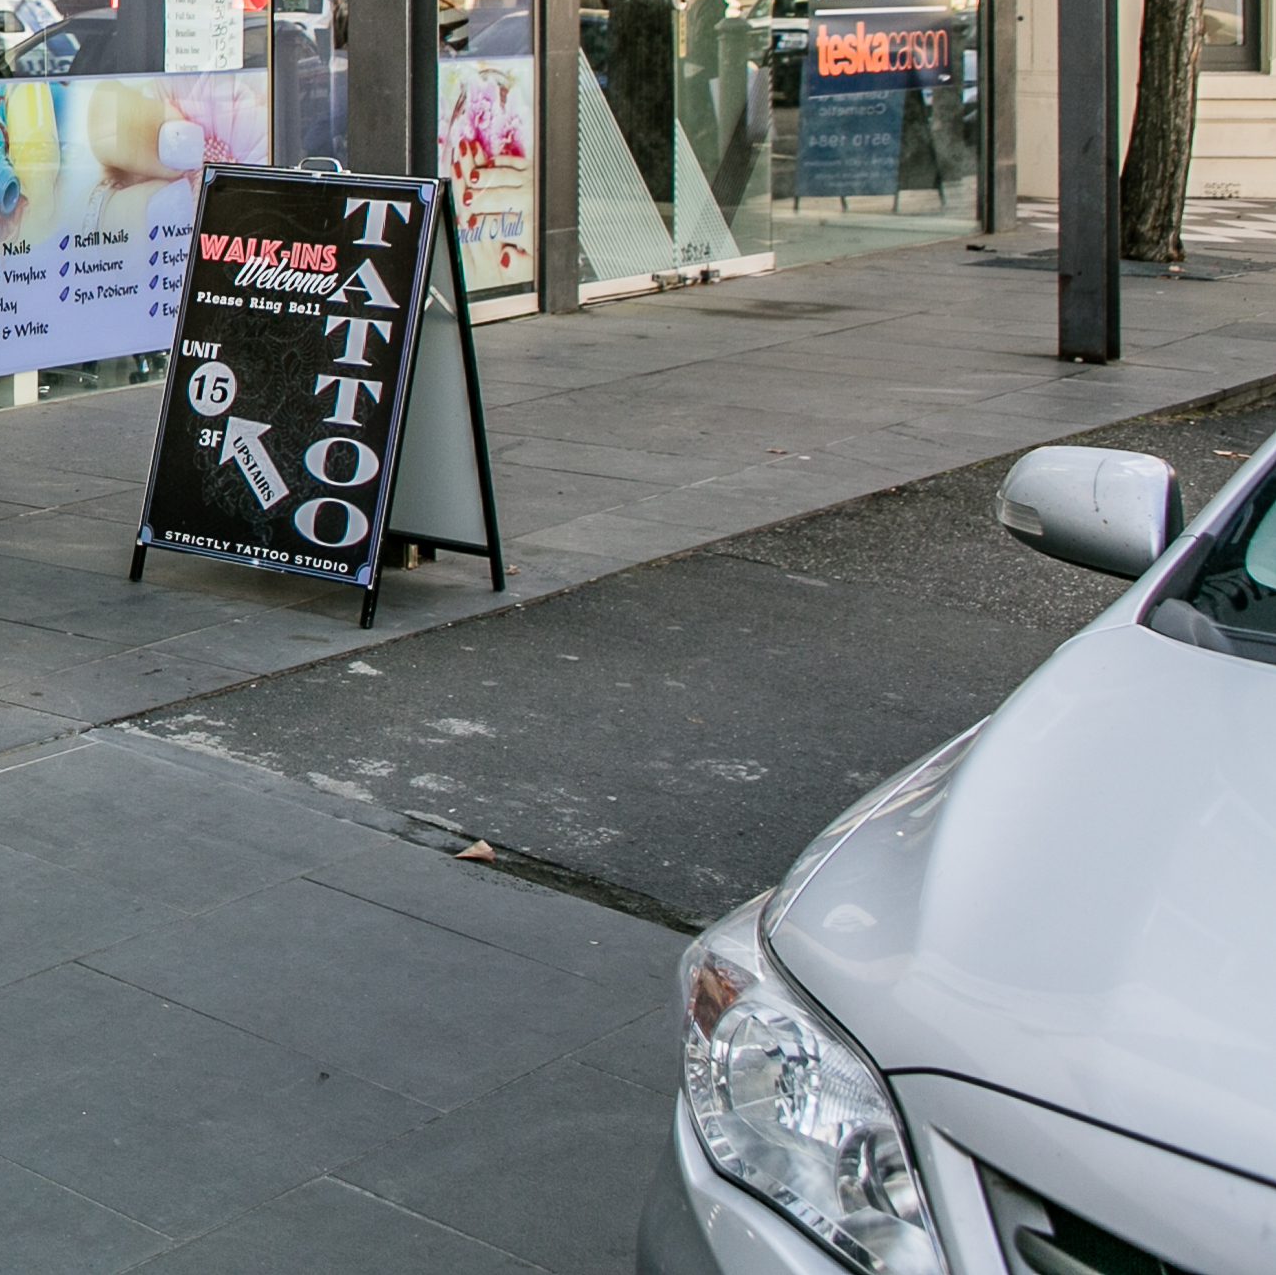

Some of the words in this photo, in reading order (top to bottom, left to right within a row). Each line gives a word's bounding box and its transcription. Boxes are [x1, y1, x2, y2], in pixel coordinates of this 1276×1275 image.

[816, 20, 948, 76] teskacarson
[2, 239, 31, 257] Nails
[74, 230, 100, 249] Refill
[102, 229, 129, 245] Nails
[199, 233, 338, 273] WALK-INS
[3, 267, 47, 285] Vinylux
[74, 259, 123, 275] Manicure
[234, 255, 338, 296] Welcome
[74, 287, 95, 305] Spa
[97, 283, 139, 300] Pedicure
[196, 291, 244, 308] Please
[249, 297, 283, 314] Ring
[288, 299, 322, 316] Bell
[2, 326, 12, 340] &
[14, 321, 49, 338] White
[181, 339, 222, 360] UNIT
[293, 197, 412, 548] TATTOO
[192, 373, 230, 405] 15
[198, 428, 223, 448] 3F
[232, 435, 276, 504] UPSTAIRS
[164, 529, 231, 552] STRICTLY
[236, 543, 290, 562] TATTOO
[294, 555, 349, 574] STUDIO
